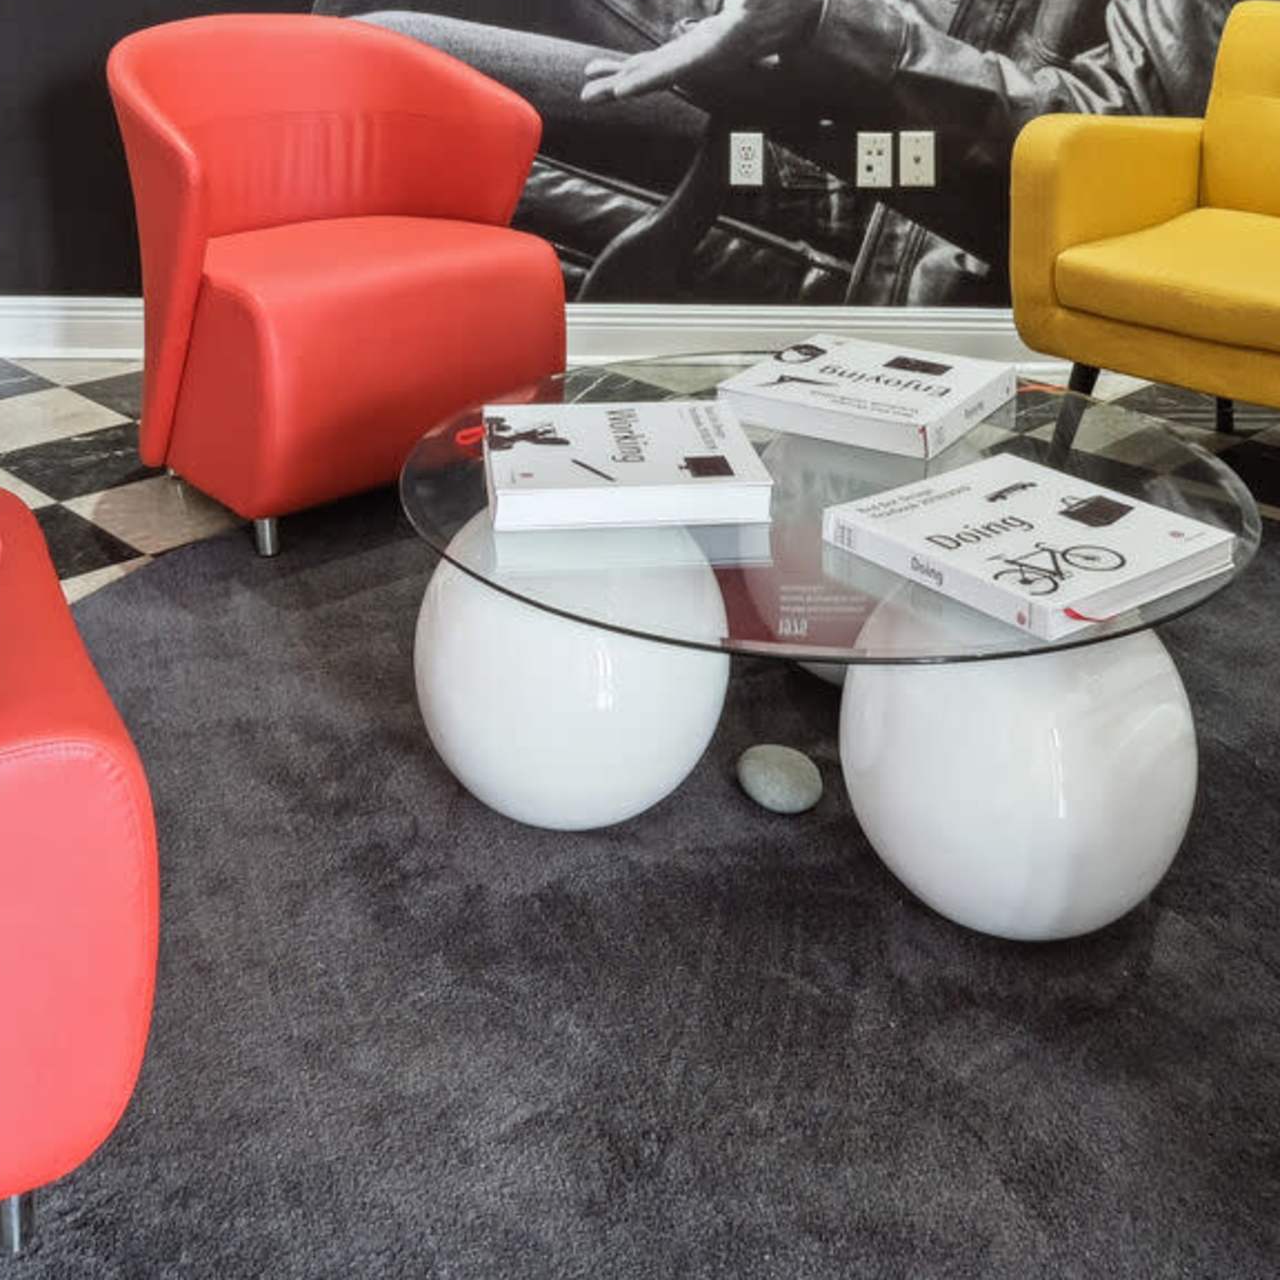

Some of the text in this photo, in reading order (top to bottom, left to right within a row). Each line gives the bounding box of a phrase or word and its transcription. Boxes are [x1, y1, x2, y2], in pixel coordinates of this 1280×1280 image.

[819, 364, 953, 397] Enjoying
[606, 408, 646, 464] Working
[924, 515, 1036, 551] Doing
[910, 555, 944, 587] Doing
